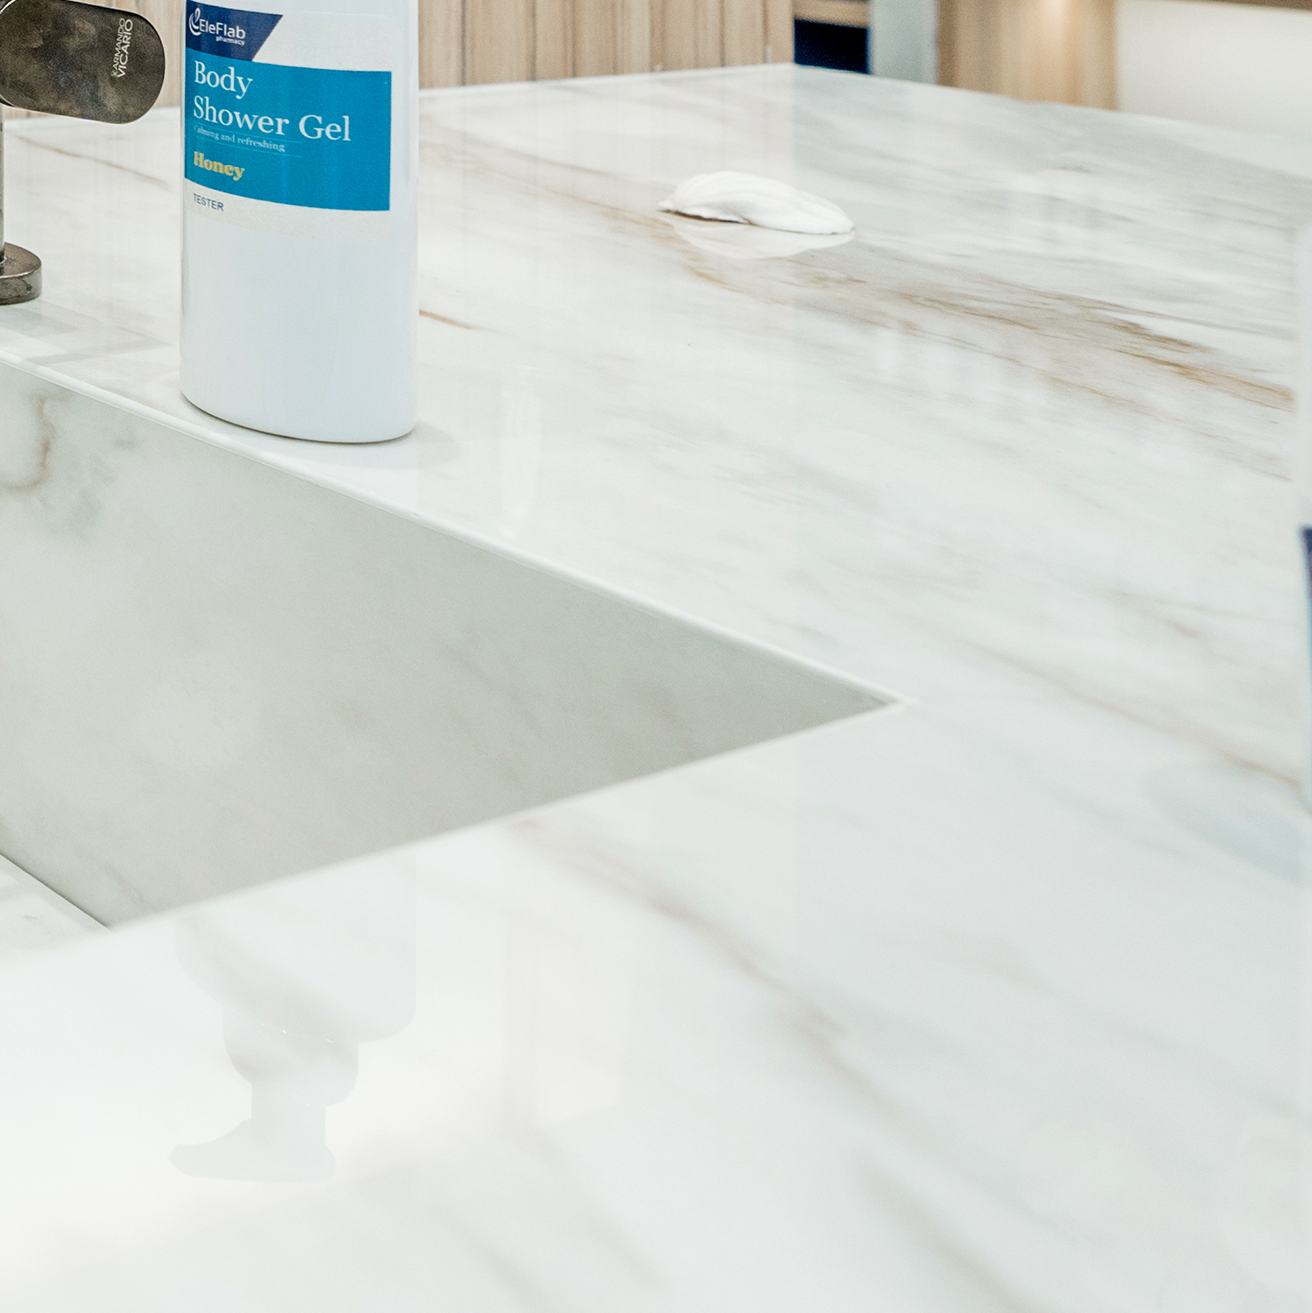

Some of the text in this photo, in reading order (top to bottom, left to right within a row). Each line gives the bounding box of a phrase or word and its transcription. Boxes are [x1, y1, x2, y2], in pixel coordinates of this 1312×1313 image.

[113, 17, 126, 71] ARMANDO
[199, 18, 246, 39] EleFlab
[215, 35, 245, 47] pharmacy
[117, 19, 133, 78] VICARIO
[193, 60, 253, 99] Body
[193, 95, 351, 142] Shower Gel
[221, 134, 235, 142] and
[237, 137, 285, 152] refreshing
[193, 150, 245, 181] Honey
[192, 192, 224, 211] TESTER
